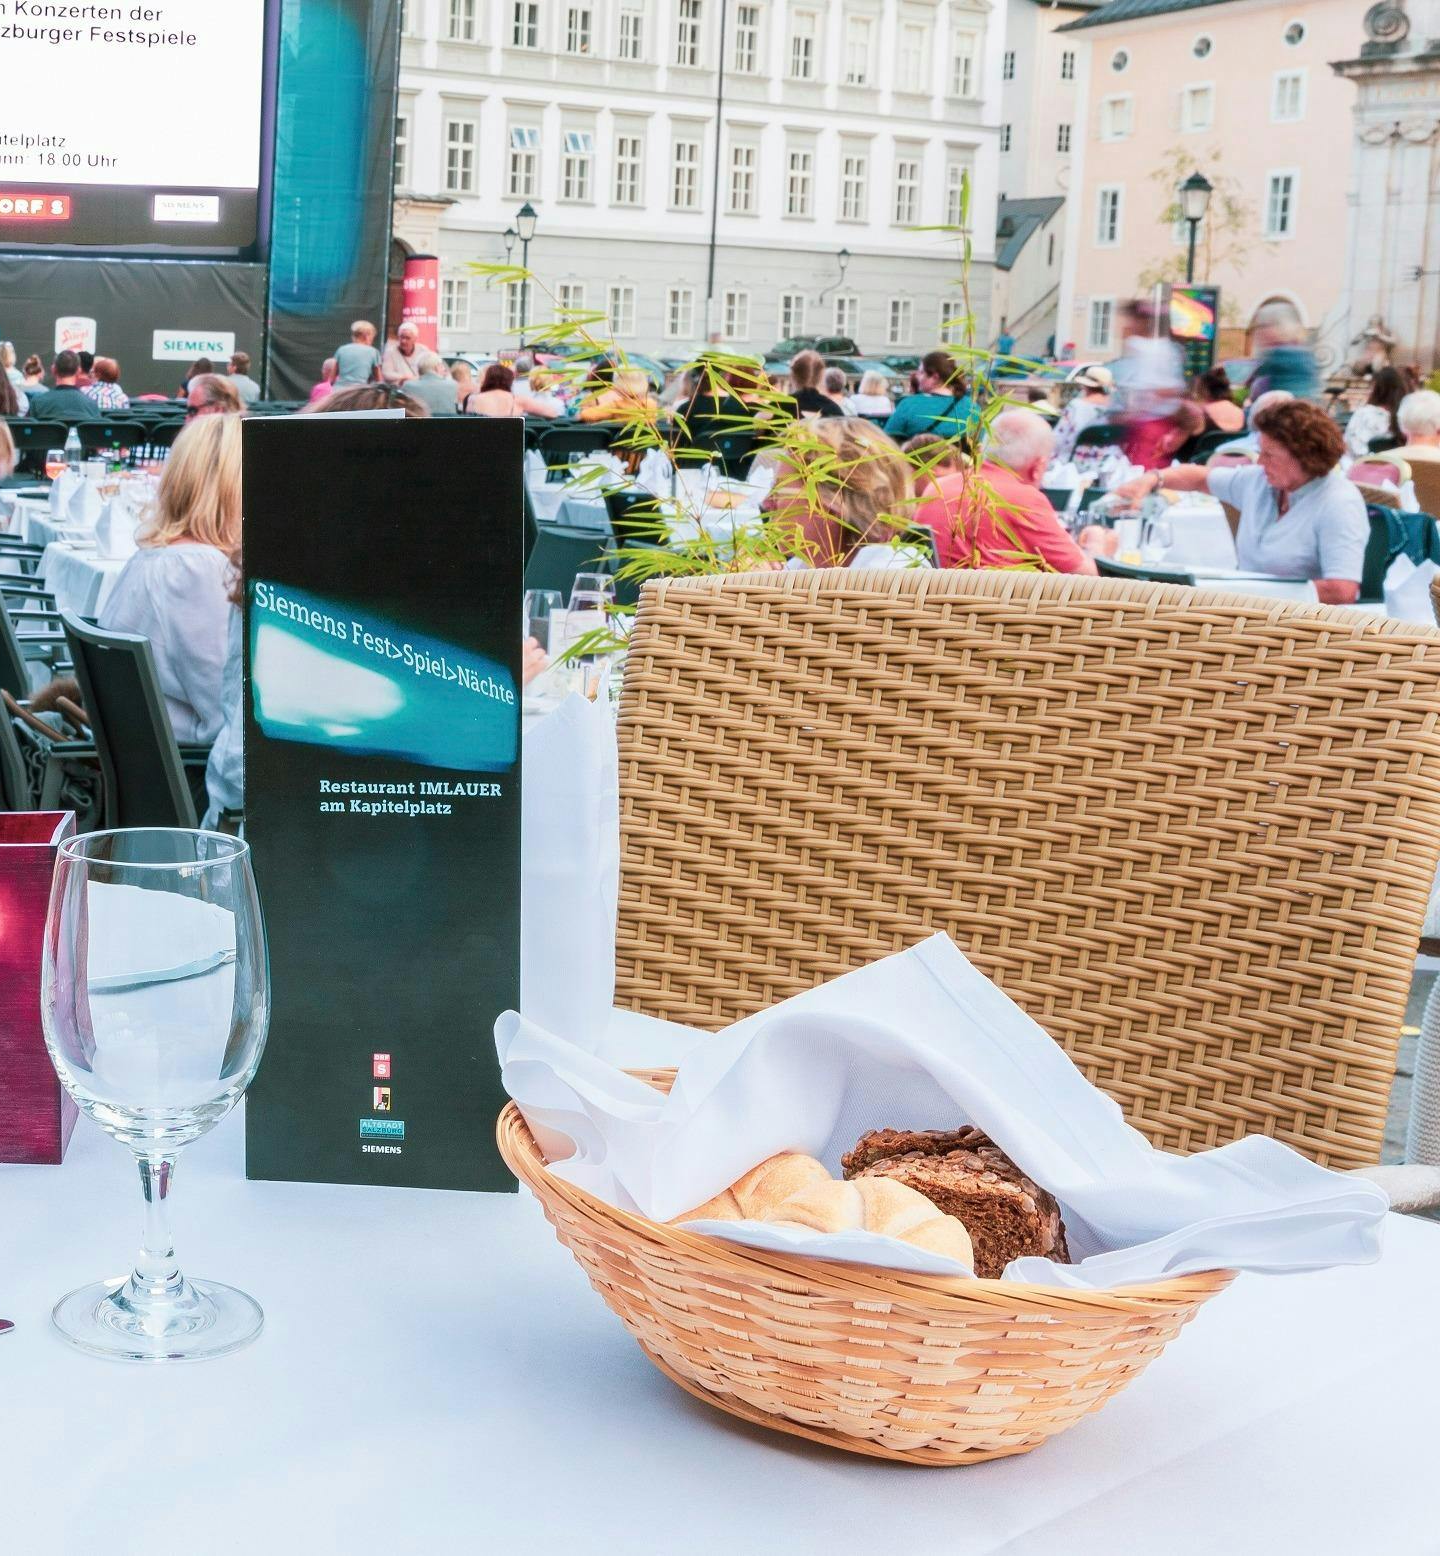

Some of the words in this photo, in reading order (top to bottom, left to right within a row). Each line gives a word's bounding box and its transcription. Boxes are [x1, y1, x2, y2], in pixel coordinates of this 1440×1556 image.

[15, 1, 122, 20] Konzerten
[129, 5, 164, 21] der
[90, 26, 197, 47] Festspiele
[87, 154, 119, 168] Uhr
[50, 200, 65, 215] S
[163, 340, 224, 352] SIEMENS
[255, 581, 347, 640] Siemens
[319, 779, 415, 795] Restaurant
[420, 781, 502, 797] IMLAUER
[319, 801, 346, 813] am
[350, 799, 452, 816] Kapitelplatz
[362, 1145, 402, 1154] SIEMENS
